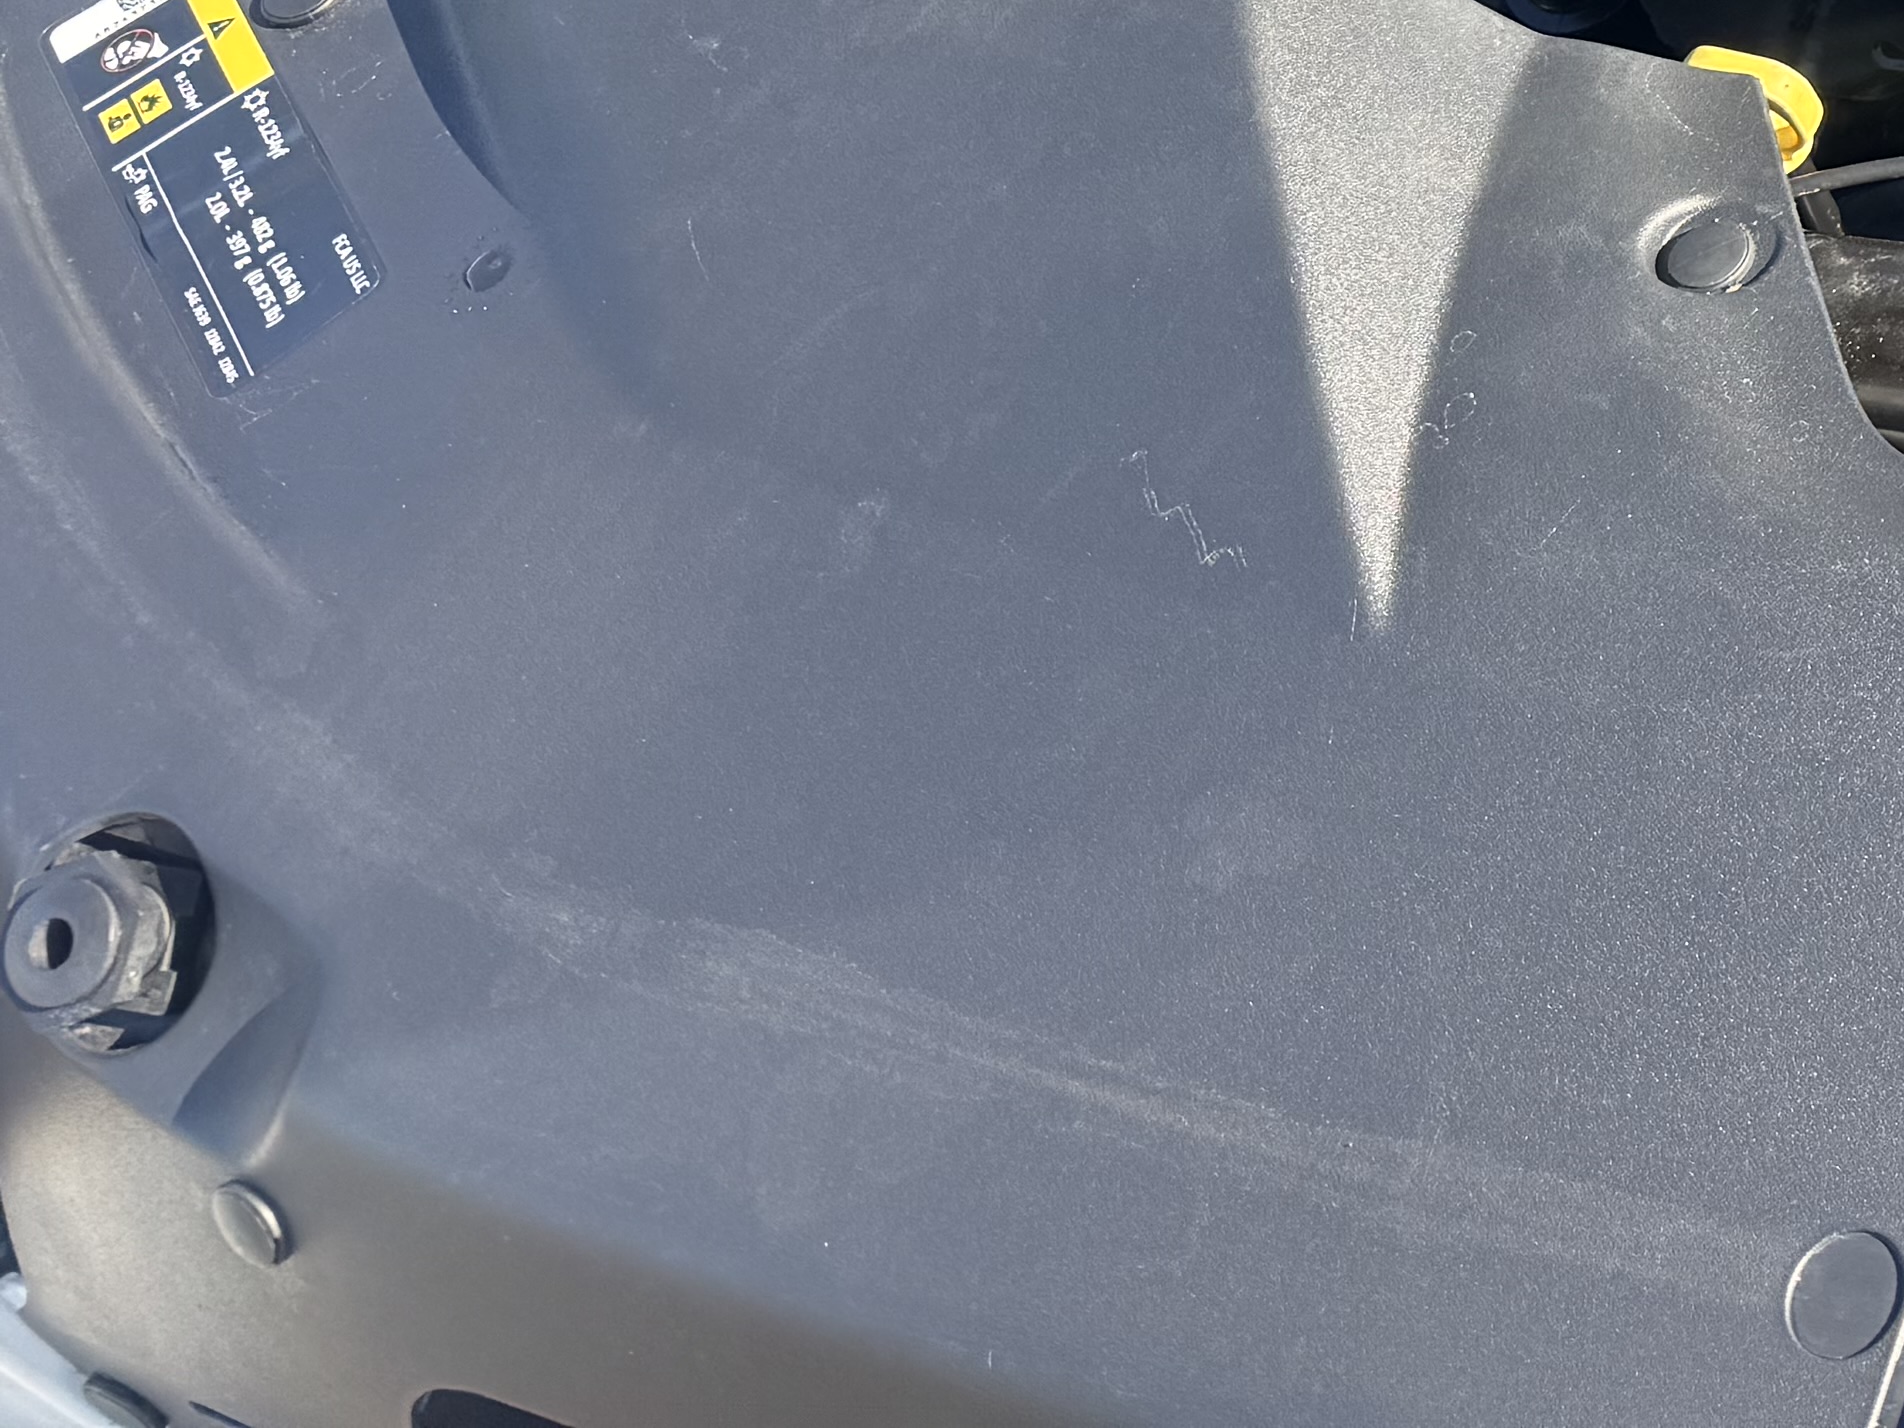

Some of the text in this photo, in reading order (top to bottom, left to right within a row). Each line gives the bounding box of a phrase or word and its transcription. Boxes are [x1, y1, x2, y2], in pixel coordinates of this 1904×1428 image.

[251, 106, 291, 161] R-1234yf
[133, 184, 159, 214] PAG
[205, 192, 230, 224] 2.0L
[226, 230, 251, 256] 397
[242, 268, 277, 310] (0.875
[251, 216, 274, 242] 482
[331, 233, 371, 295] FCA US LLC
